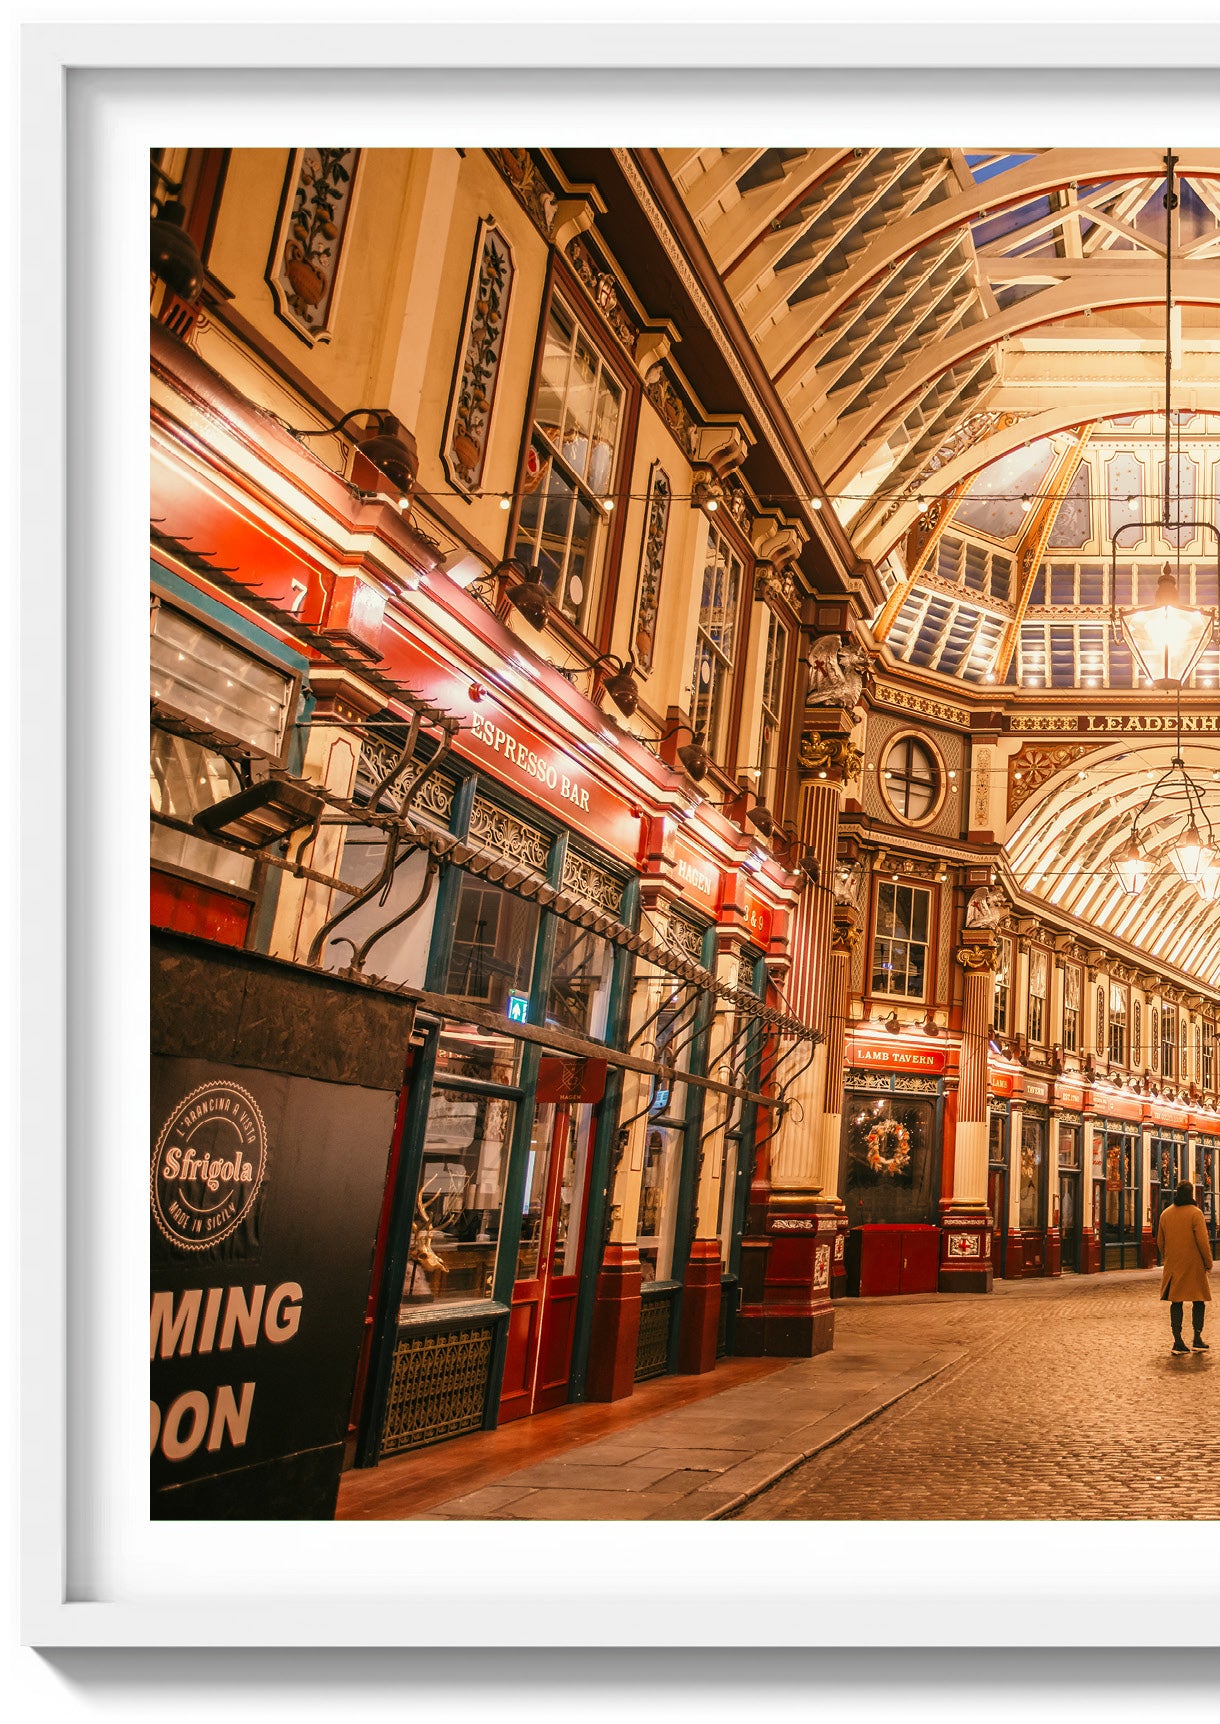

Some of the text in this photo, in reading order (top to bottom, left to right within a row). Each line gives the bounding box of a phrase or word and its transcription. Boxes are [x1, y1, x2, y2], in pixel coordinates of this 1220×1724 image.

[291, 577, 308, 613] 7
[470, 710, 590, 813] ESPRESSO BAR
[678, 859, 711, 897] HAGEN
[750, 910, 757, 928] &
[857, 1050, 935, 1065] LAMB TAVERN
[992, 1078, 1008, 1089] LAMB
[176, 1099, 257, 1144] L'ARANCINA A VISTA
[163, 1148, 253, 1192] Sfrigola
[168, 1201, 236, 1233] MADE IN SICILY
[150, 1381, 257, 1462] ON
